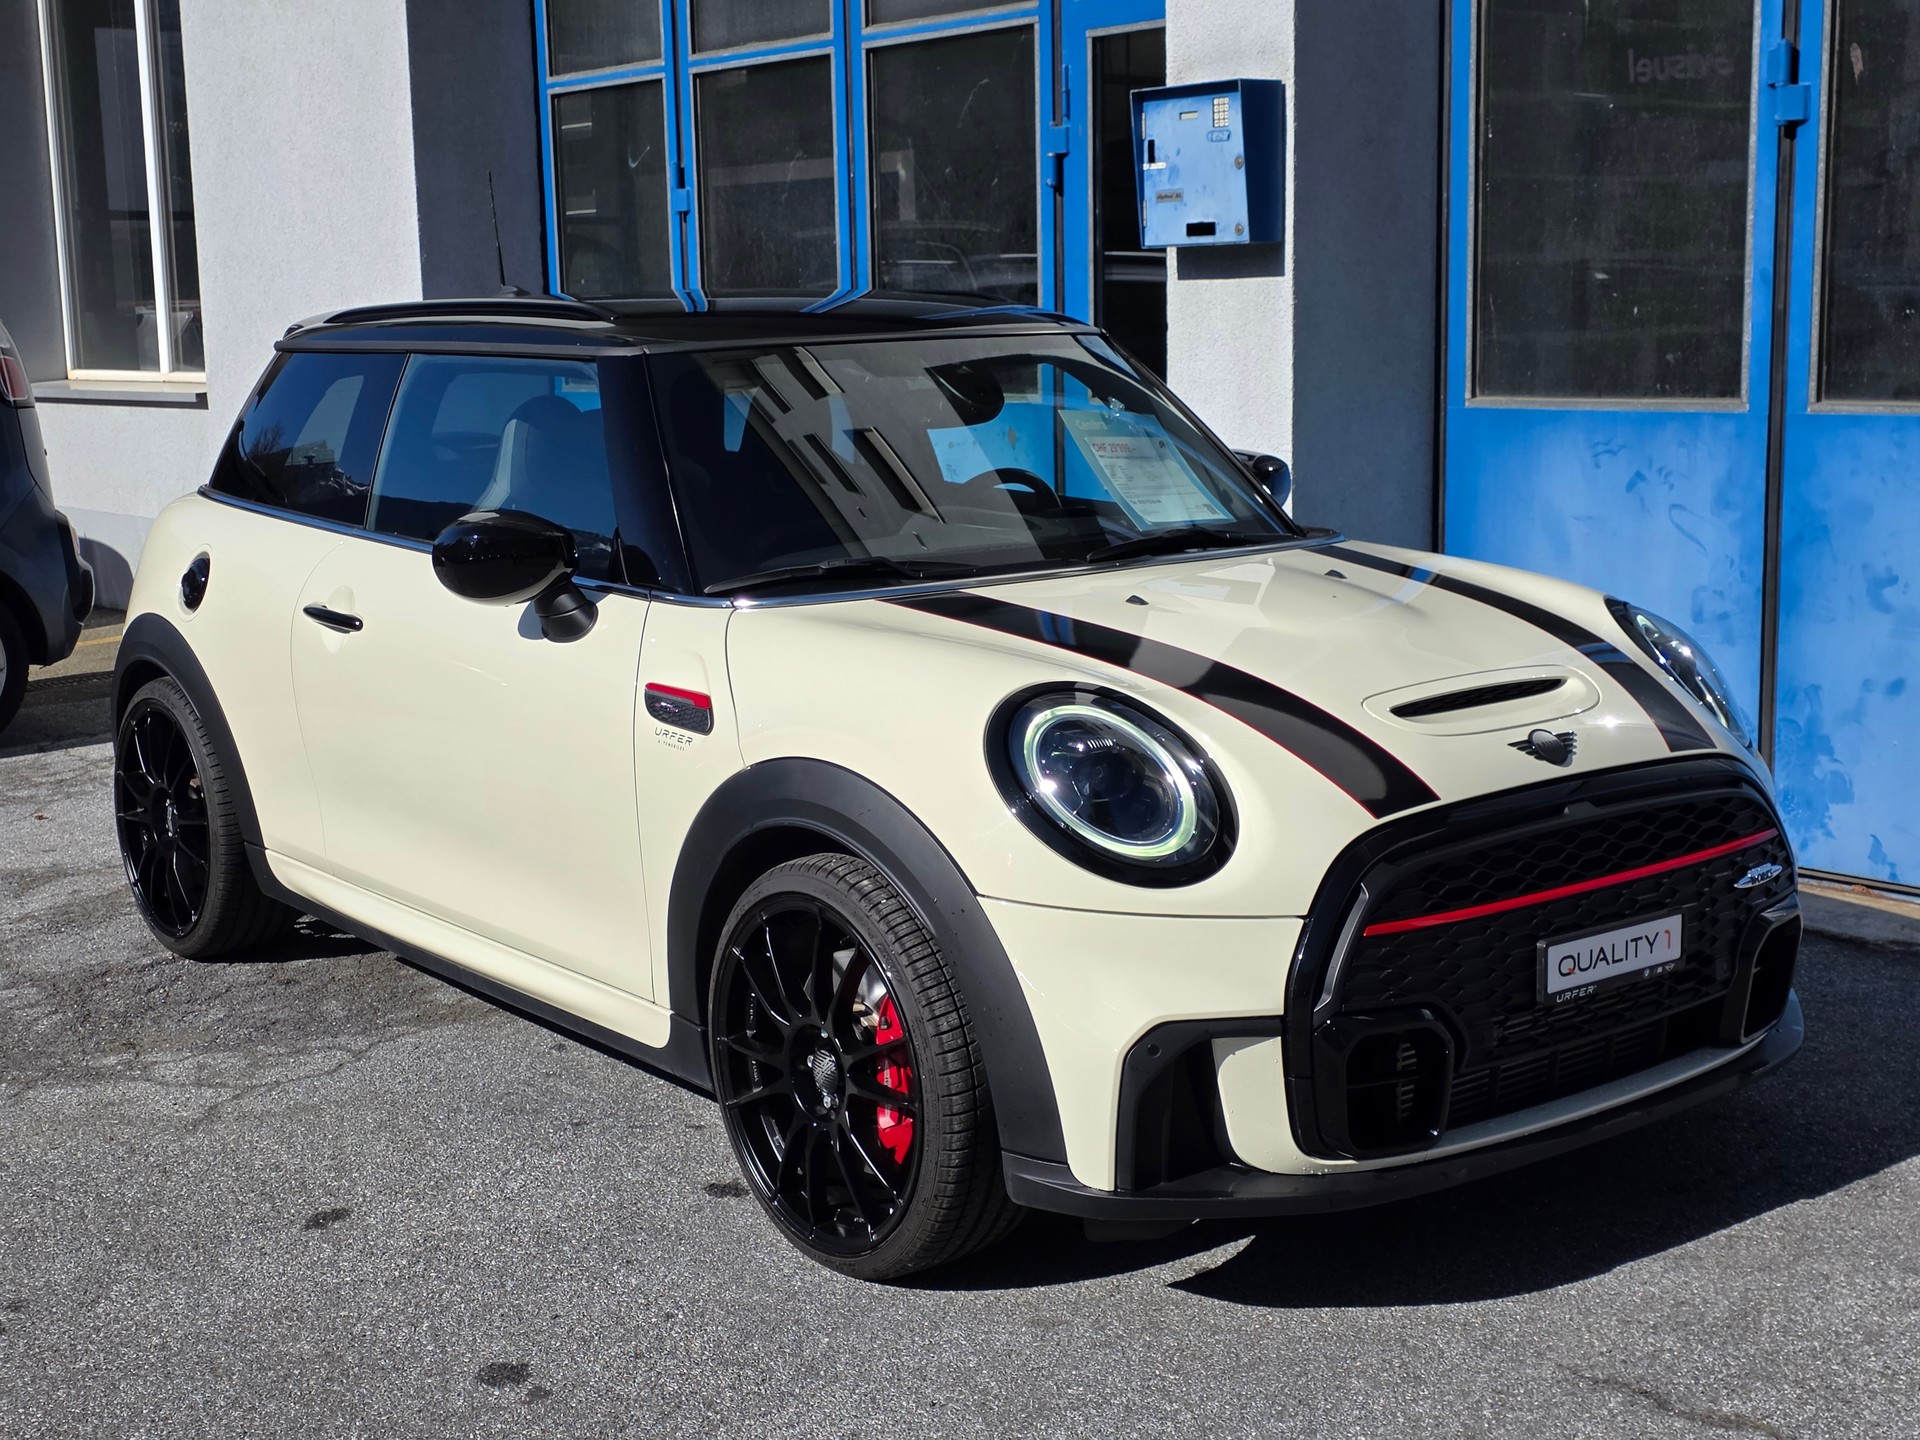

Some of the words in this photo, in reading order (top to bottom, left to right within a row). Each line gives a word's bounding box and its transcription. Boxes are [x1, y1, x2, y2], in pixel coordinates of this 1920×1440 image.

[654, 726, 694, 746] URFER
[1558, 932, 1660, 977] QUALITY
[1664, 929, 1671, 950] 1
[1556, 985, 1594, 1003] URFER
